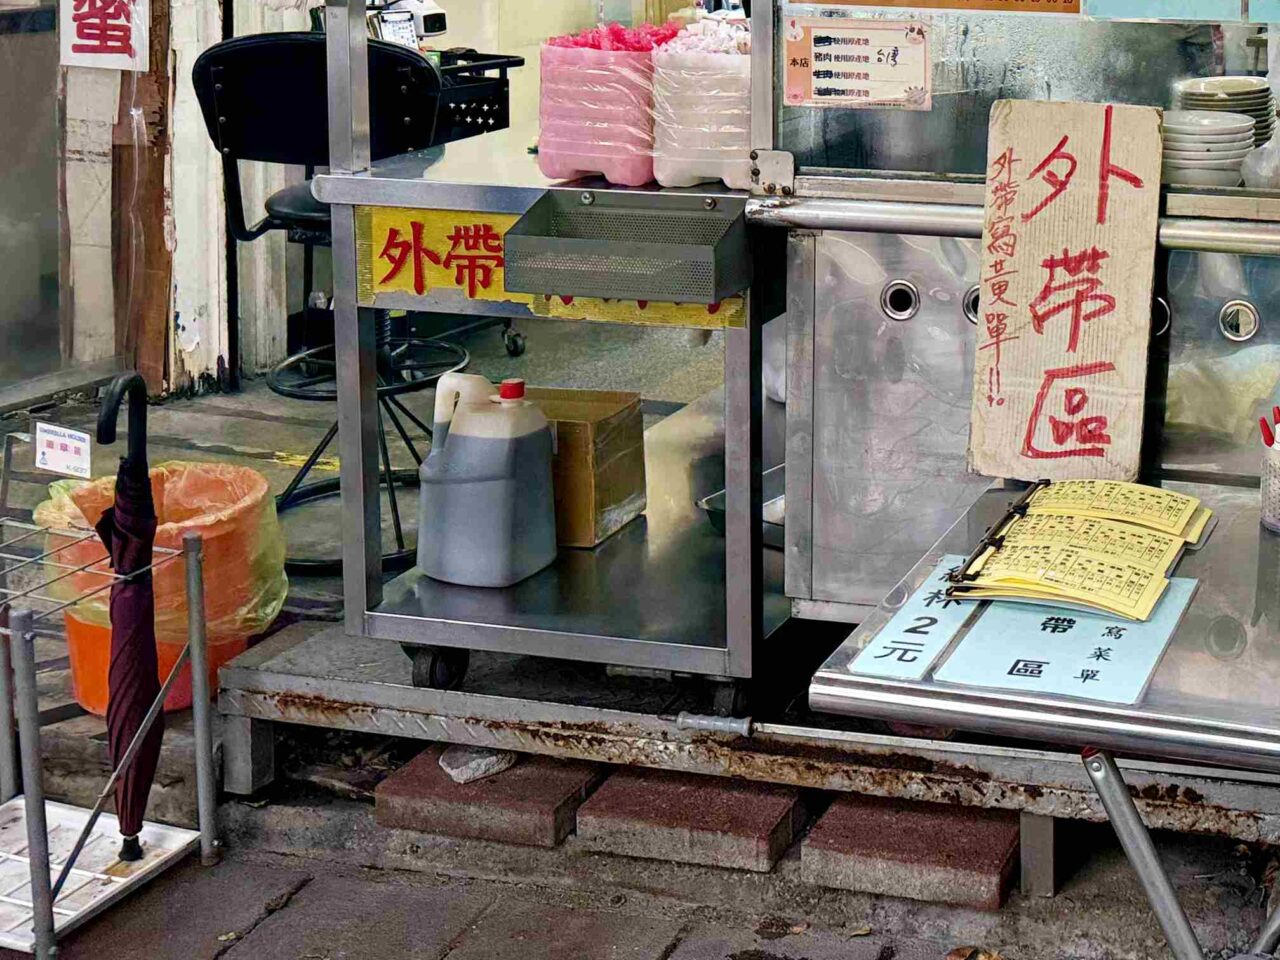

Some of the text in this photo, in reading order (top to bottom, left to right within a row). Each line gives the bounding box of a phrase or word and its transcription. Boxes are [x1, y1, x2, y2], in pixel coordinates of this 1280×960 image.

[789, 57, 810, 68] 本店
[1020, 105, 1144, 459] 外帶區
